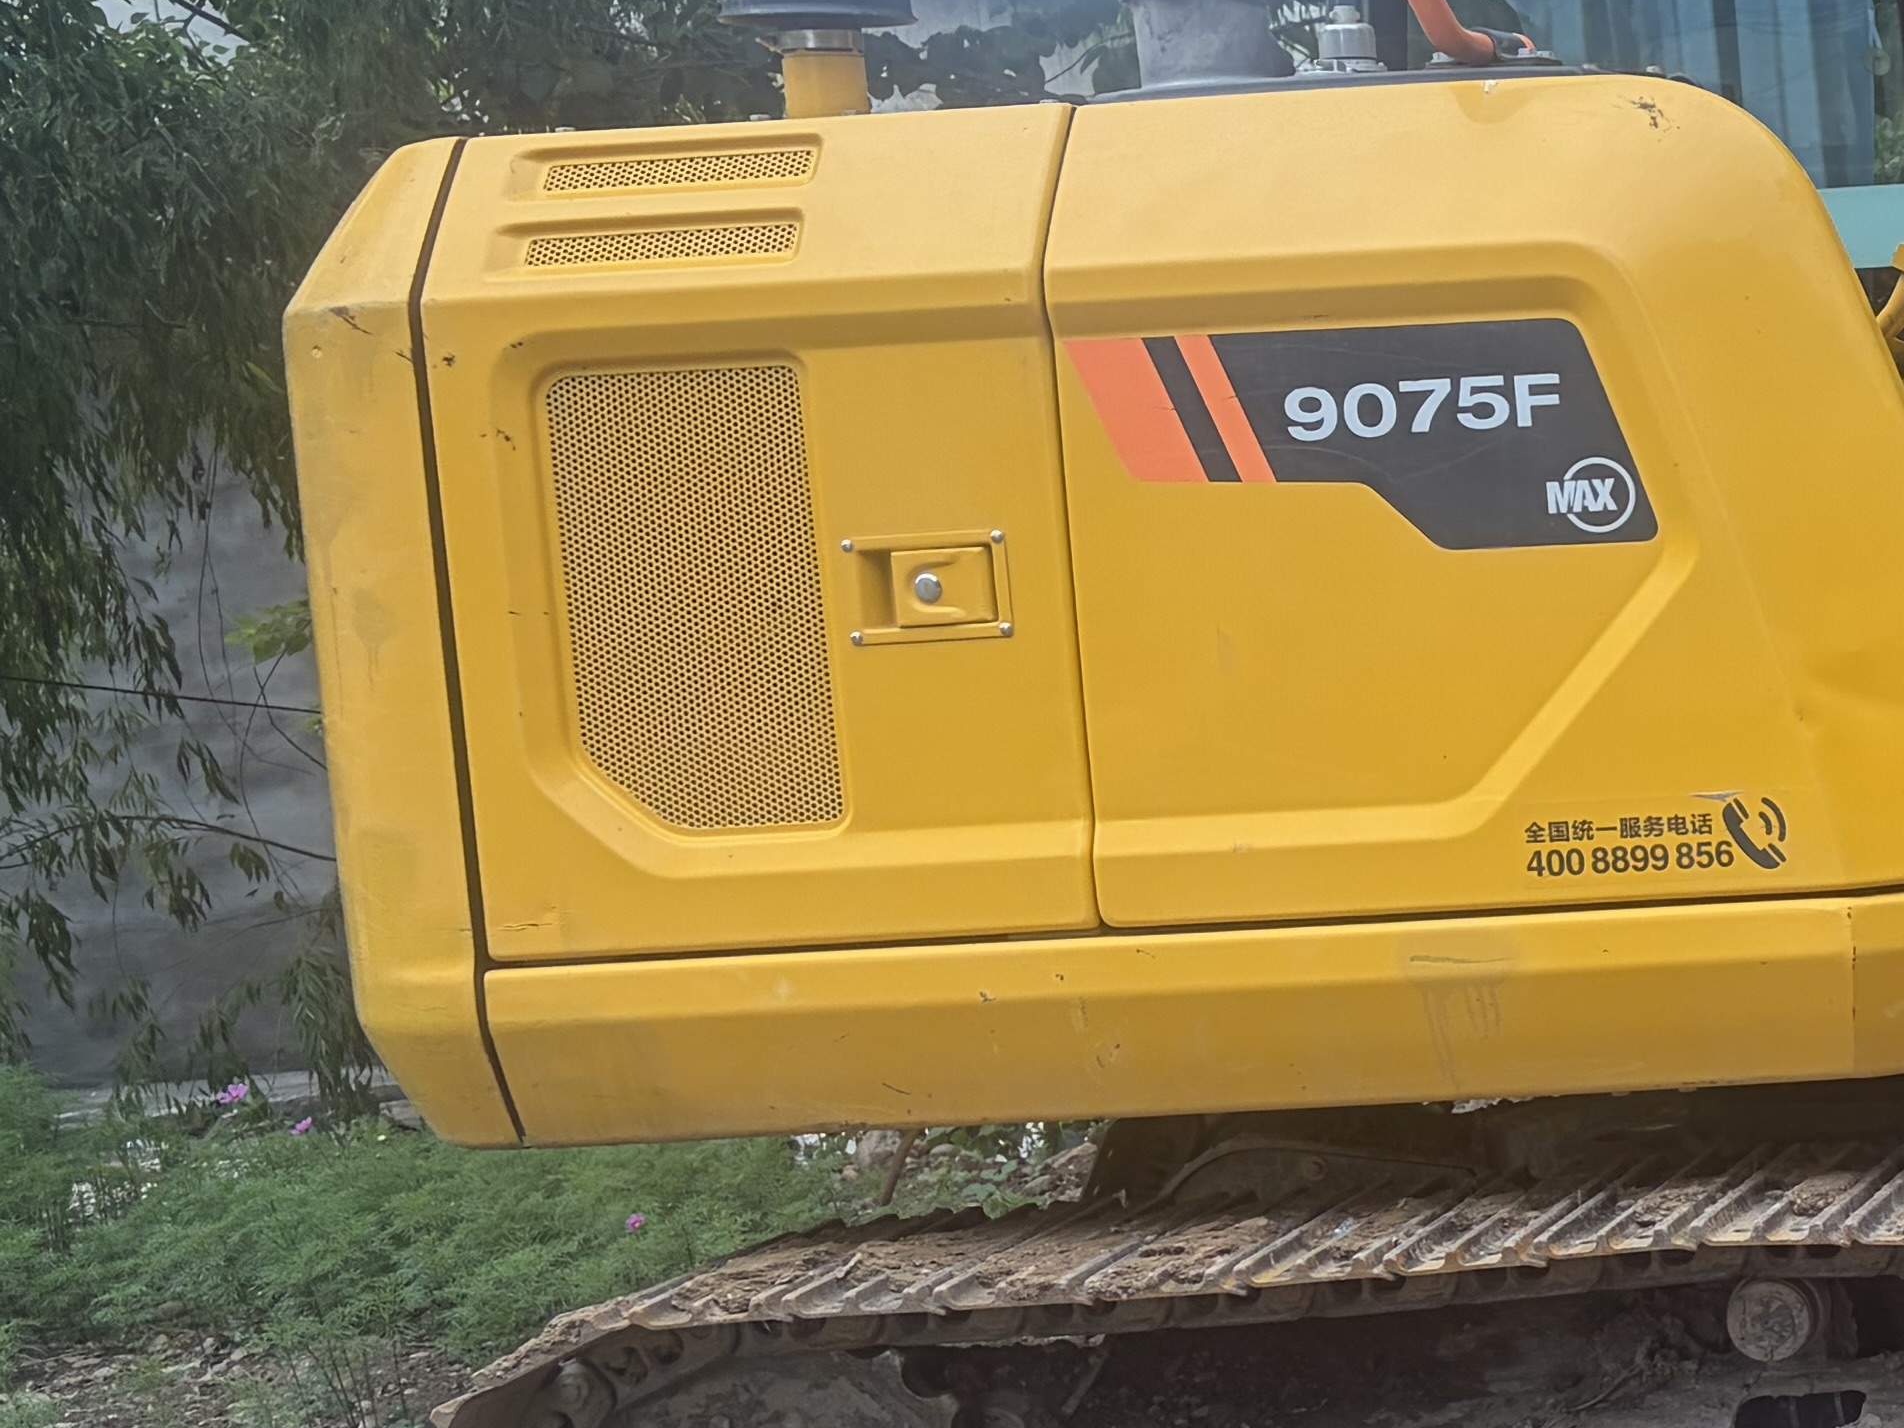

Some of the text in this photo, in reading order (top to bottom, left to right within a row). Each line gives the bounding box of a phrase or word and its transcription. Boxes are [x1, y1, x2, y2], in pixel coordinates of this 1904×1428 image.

[1283, 373, 1561, 442] 9075F
[1545, 477, 1618, 514] MAX
[1524, 813, 1713, 844] 全国统一服务电话
[1526, 839, 1735, 877] 400 8899 856
